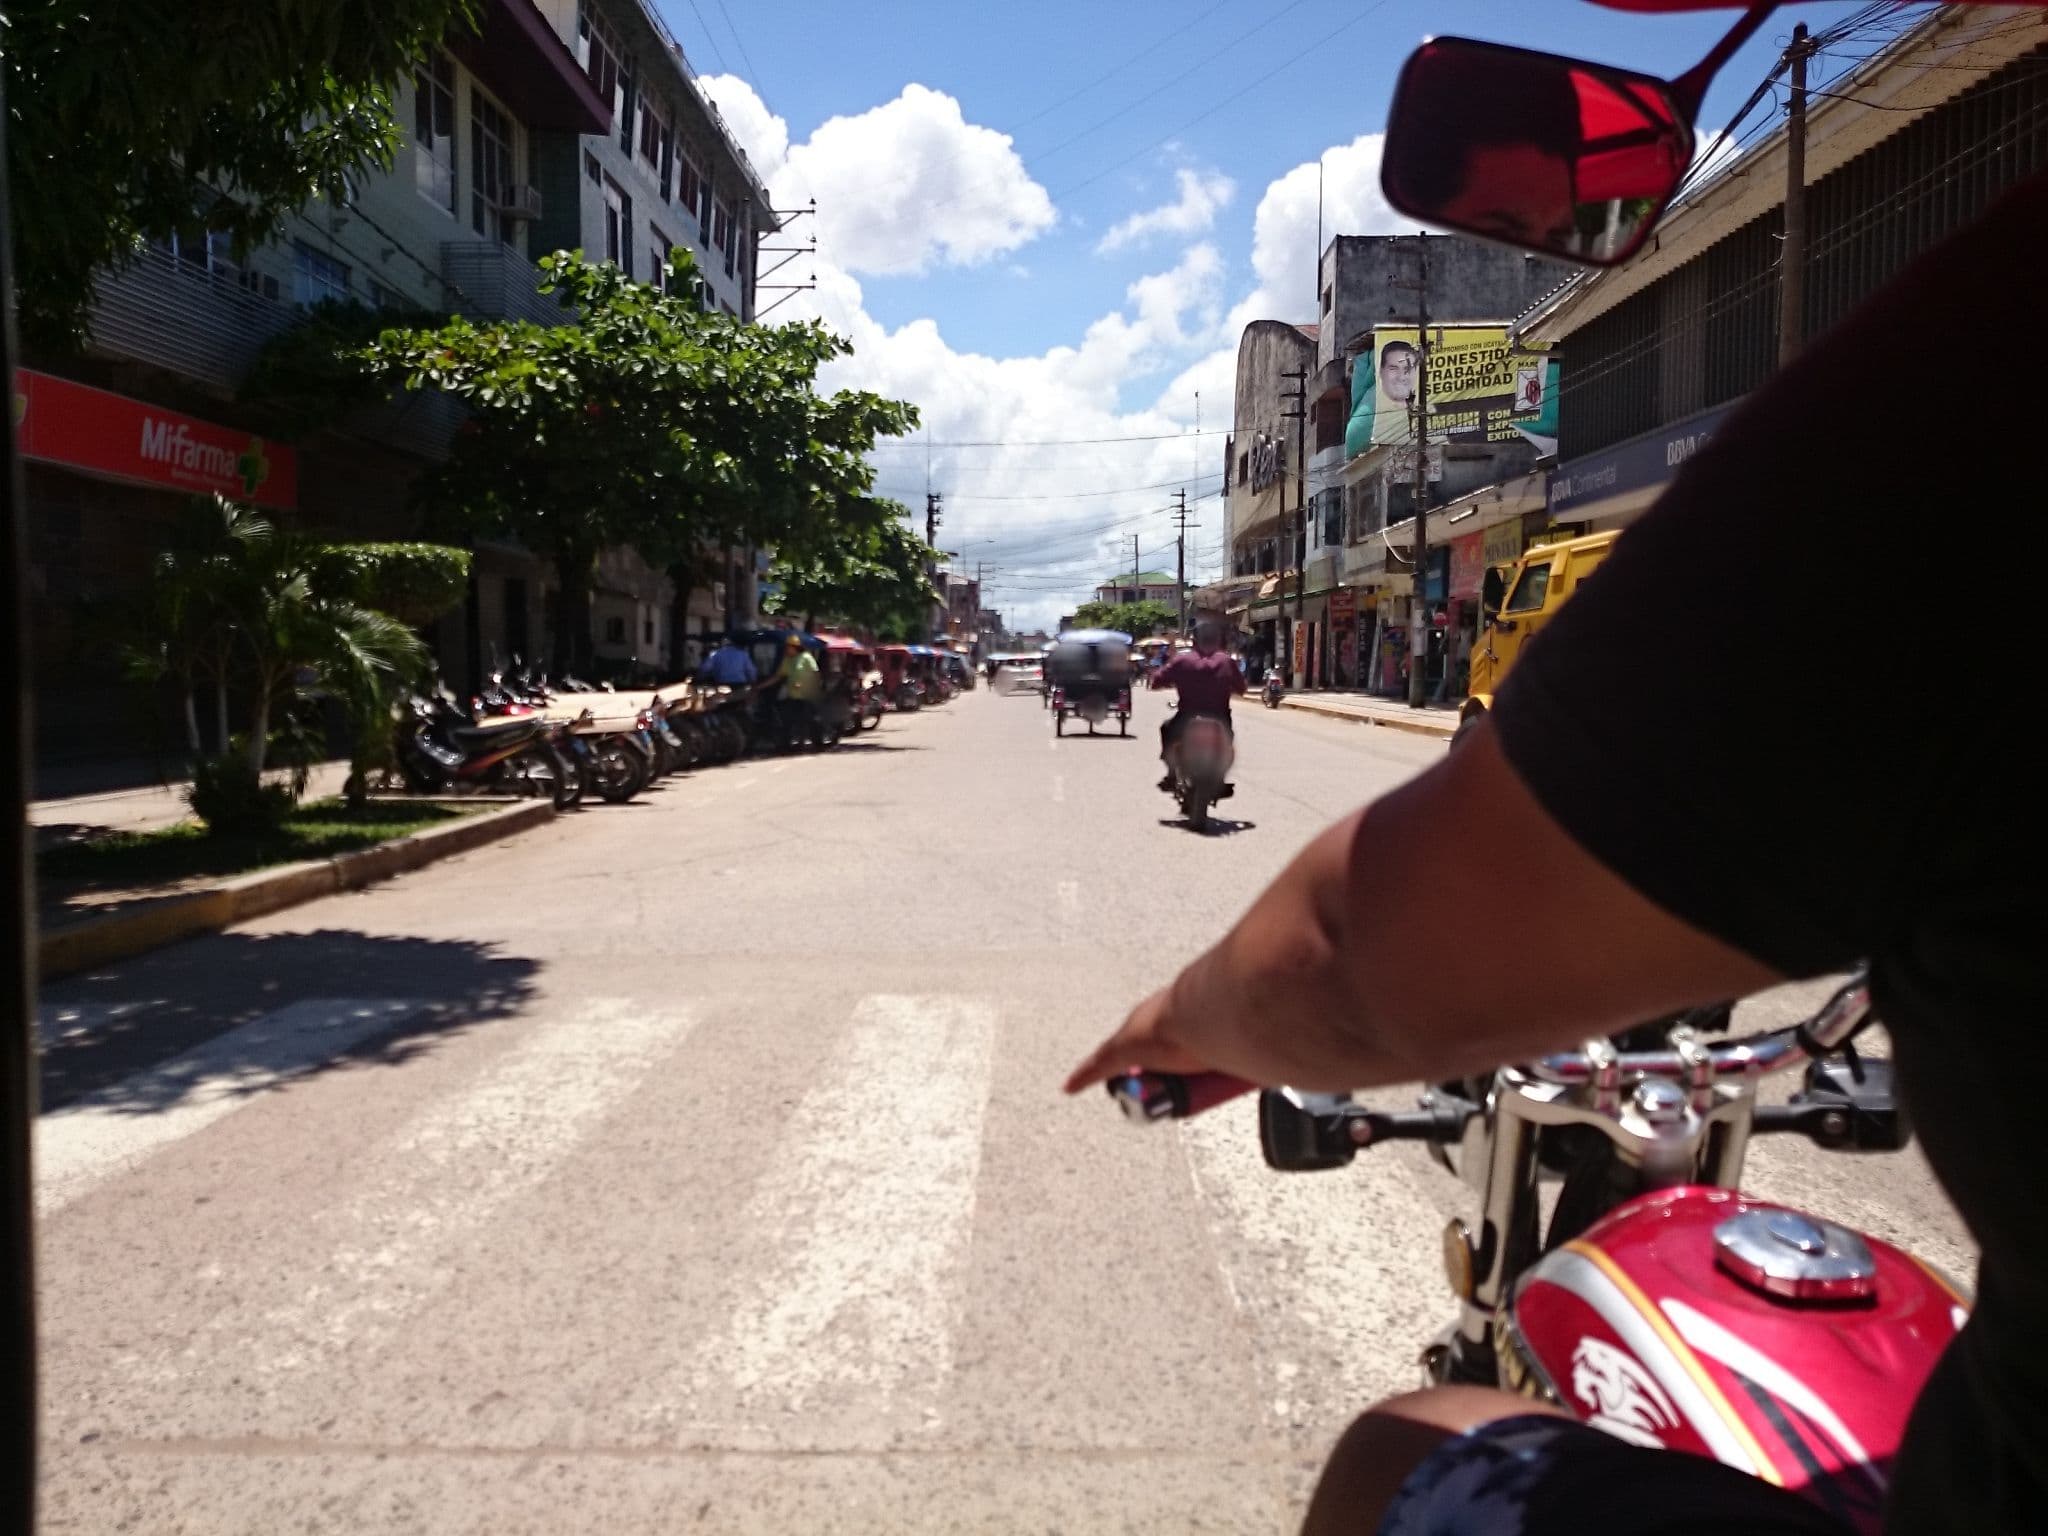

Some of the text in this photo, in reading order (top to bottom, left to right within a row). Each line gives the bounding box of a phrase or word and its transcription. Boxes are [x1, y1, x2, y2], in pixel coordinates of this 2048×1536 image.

[1426, 346, 1520, 370] HONESTIDA
[1426, 359, 1512, 382] TRABAJO Y
[1425, 373, 1513, 395] SEGURIDAD
[1487, 409, 1511, 420] CON
[1487, 414, 1540, 431] EXPIEN
[141, 416, 236, 478] Mifarma
[1667, 436, 1696, 466] BBVA
[1551, 461, 1616, 502] BBVA Continental
